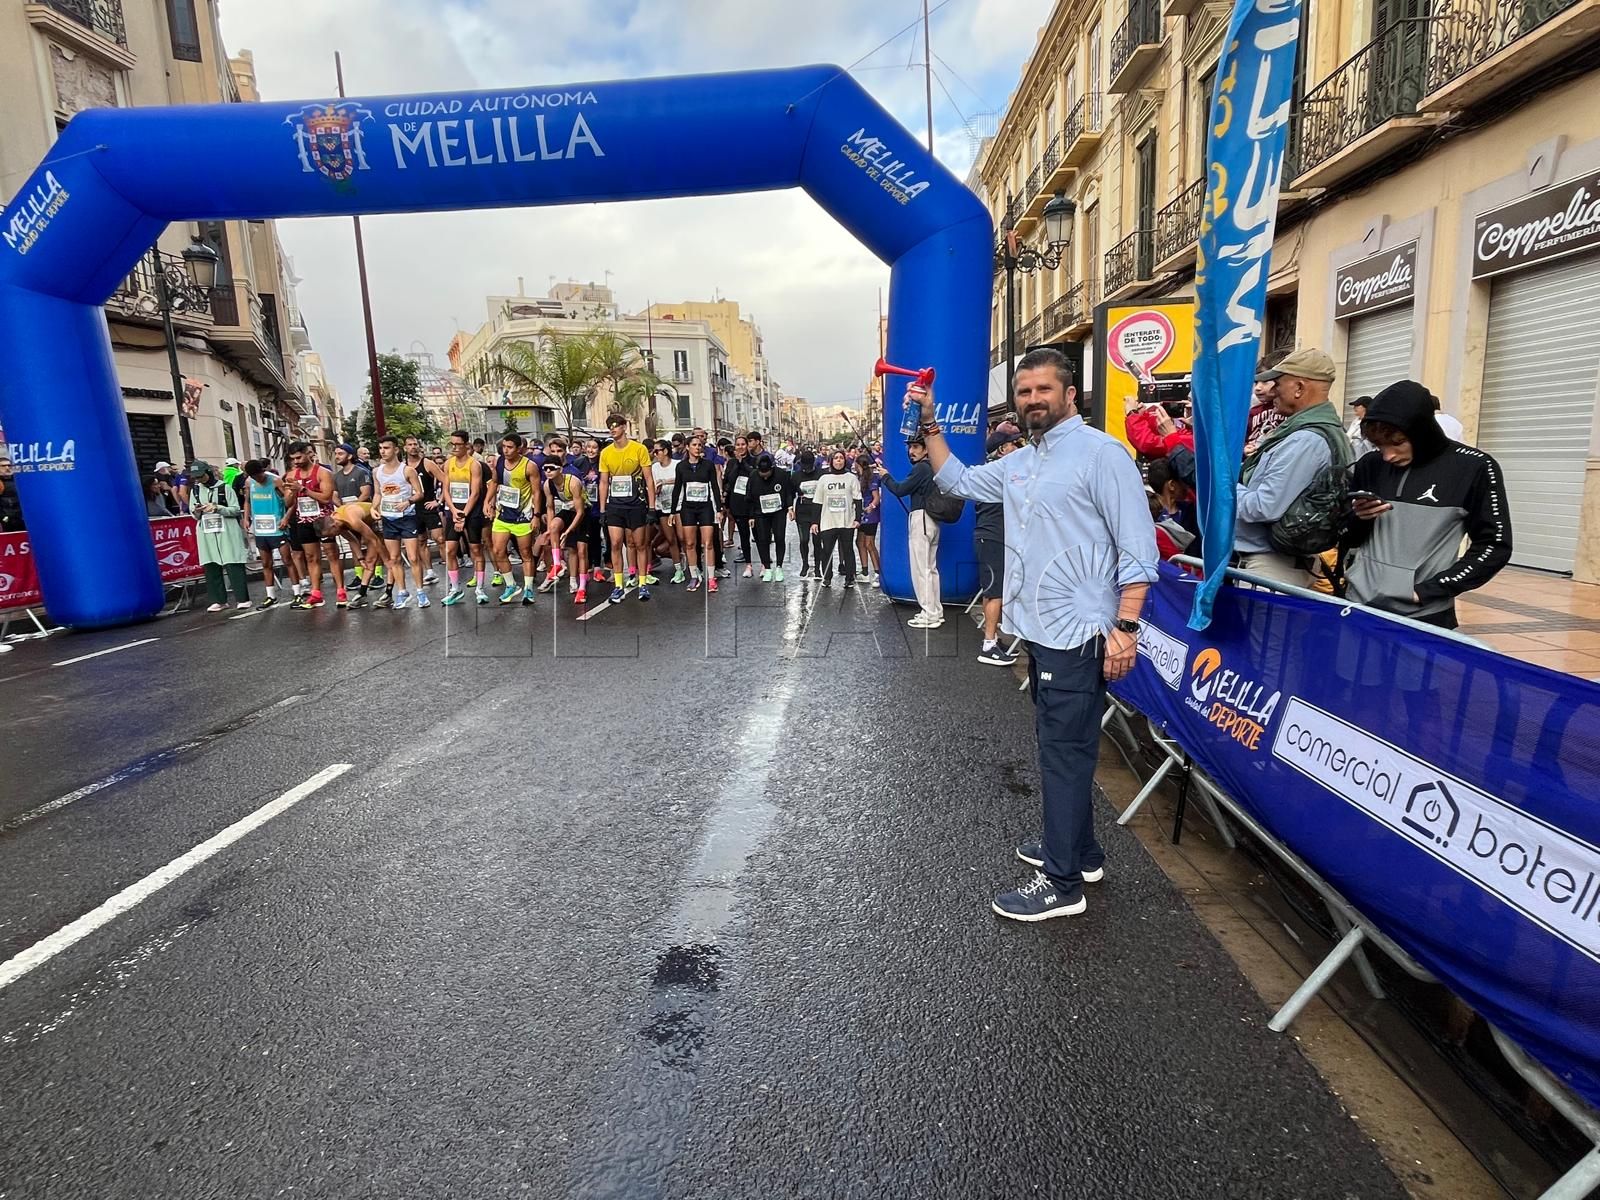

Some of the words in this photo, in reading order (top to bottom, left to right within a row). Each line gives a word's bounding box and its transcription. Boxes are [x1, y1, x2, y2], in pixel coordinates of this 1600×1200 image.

[384, 99, 463, 118] CIUDAD
[468, 90, 598, 114] AUTÓNOMA
[387, 111, 605, 169] MELILLA
[403, 121, 418, 133] DE
[840, 144, 868, 168] CIUDAD
[865, 166, 879, 182] DEL
[879, 179, 910, 205] DEPORTE
[847, 127, 931, 199] MELILLA
[2, 170, 63, 249] MELILLA
[36, 217, 50, 232] DEL
[46, 189, 70, 219] DEPORTE
[1337, 254, 1413, 306] Coppelia
[934, 402, 981, 425] LILLA
[38, 462, 75, 472] DEPORTE
[827, 482, 847, 491] GYM
[155, 525, 192, 541] RMA
[1209, 702, 1265, 750] DEPORTE
[1286, 703, 1402, 804] comercial
[1467, 813, 1600, 923] botell
